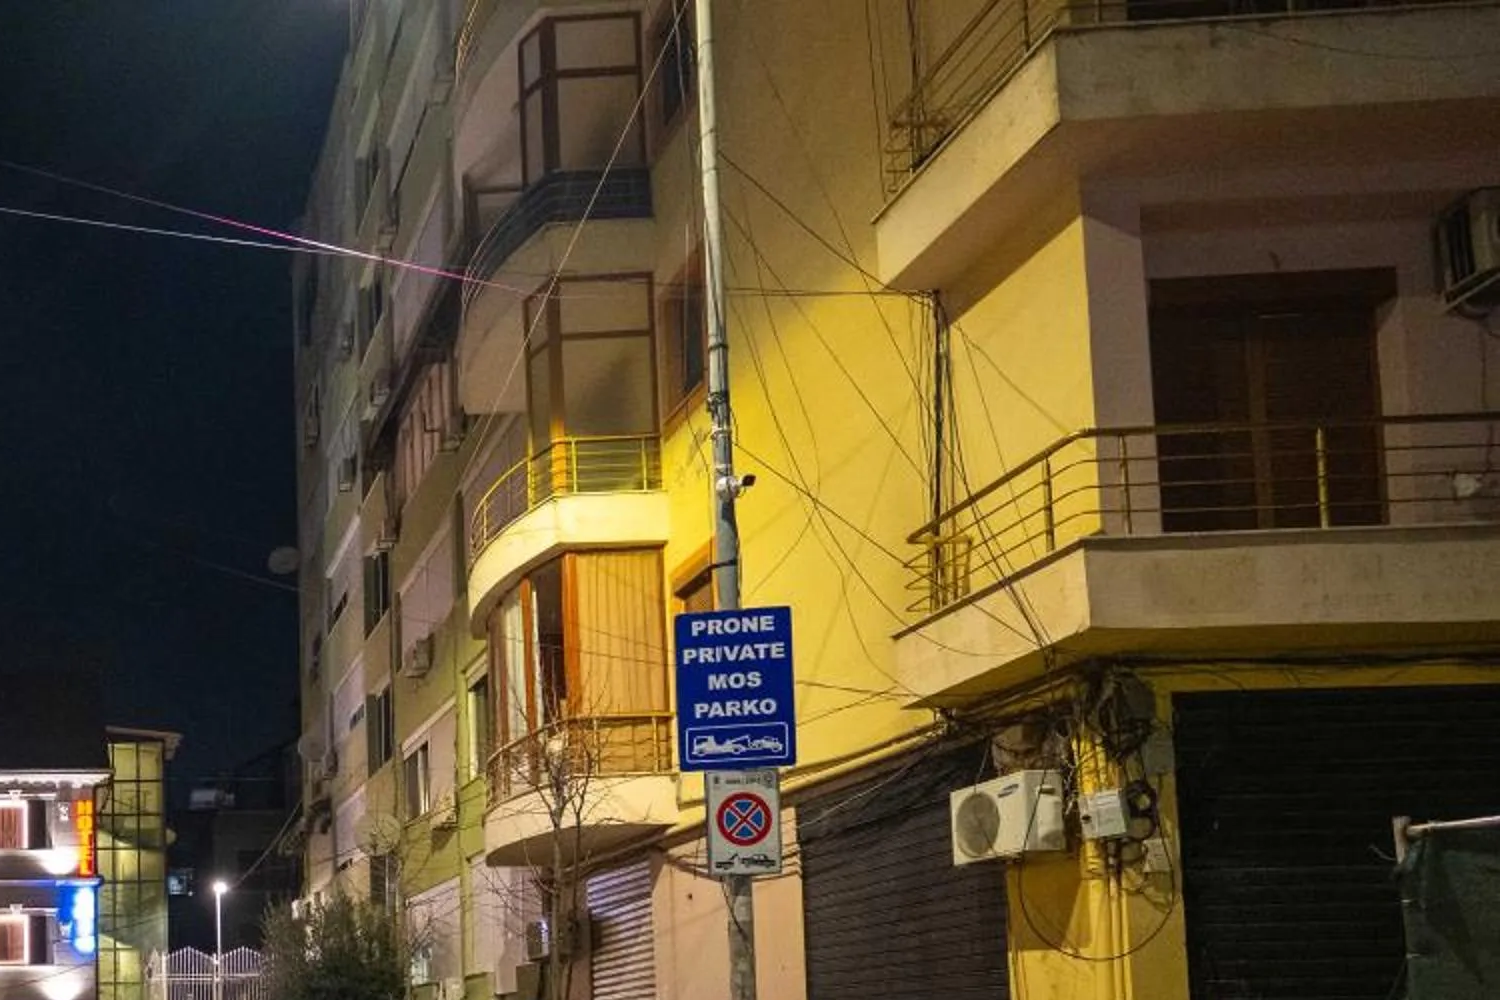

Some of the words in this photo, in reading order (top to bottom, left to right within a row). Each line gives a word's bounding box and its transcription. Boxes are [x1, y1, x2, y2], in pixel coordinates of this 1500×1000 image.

[691, 615, 775, 637] PRONE
[682, 641, 786, 664] PRIVATE
[707, 671, 762, 689] MOS
[694, 699, 777, 719] PARKO
[76, 799, 94, 877] HOTEL
